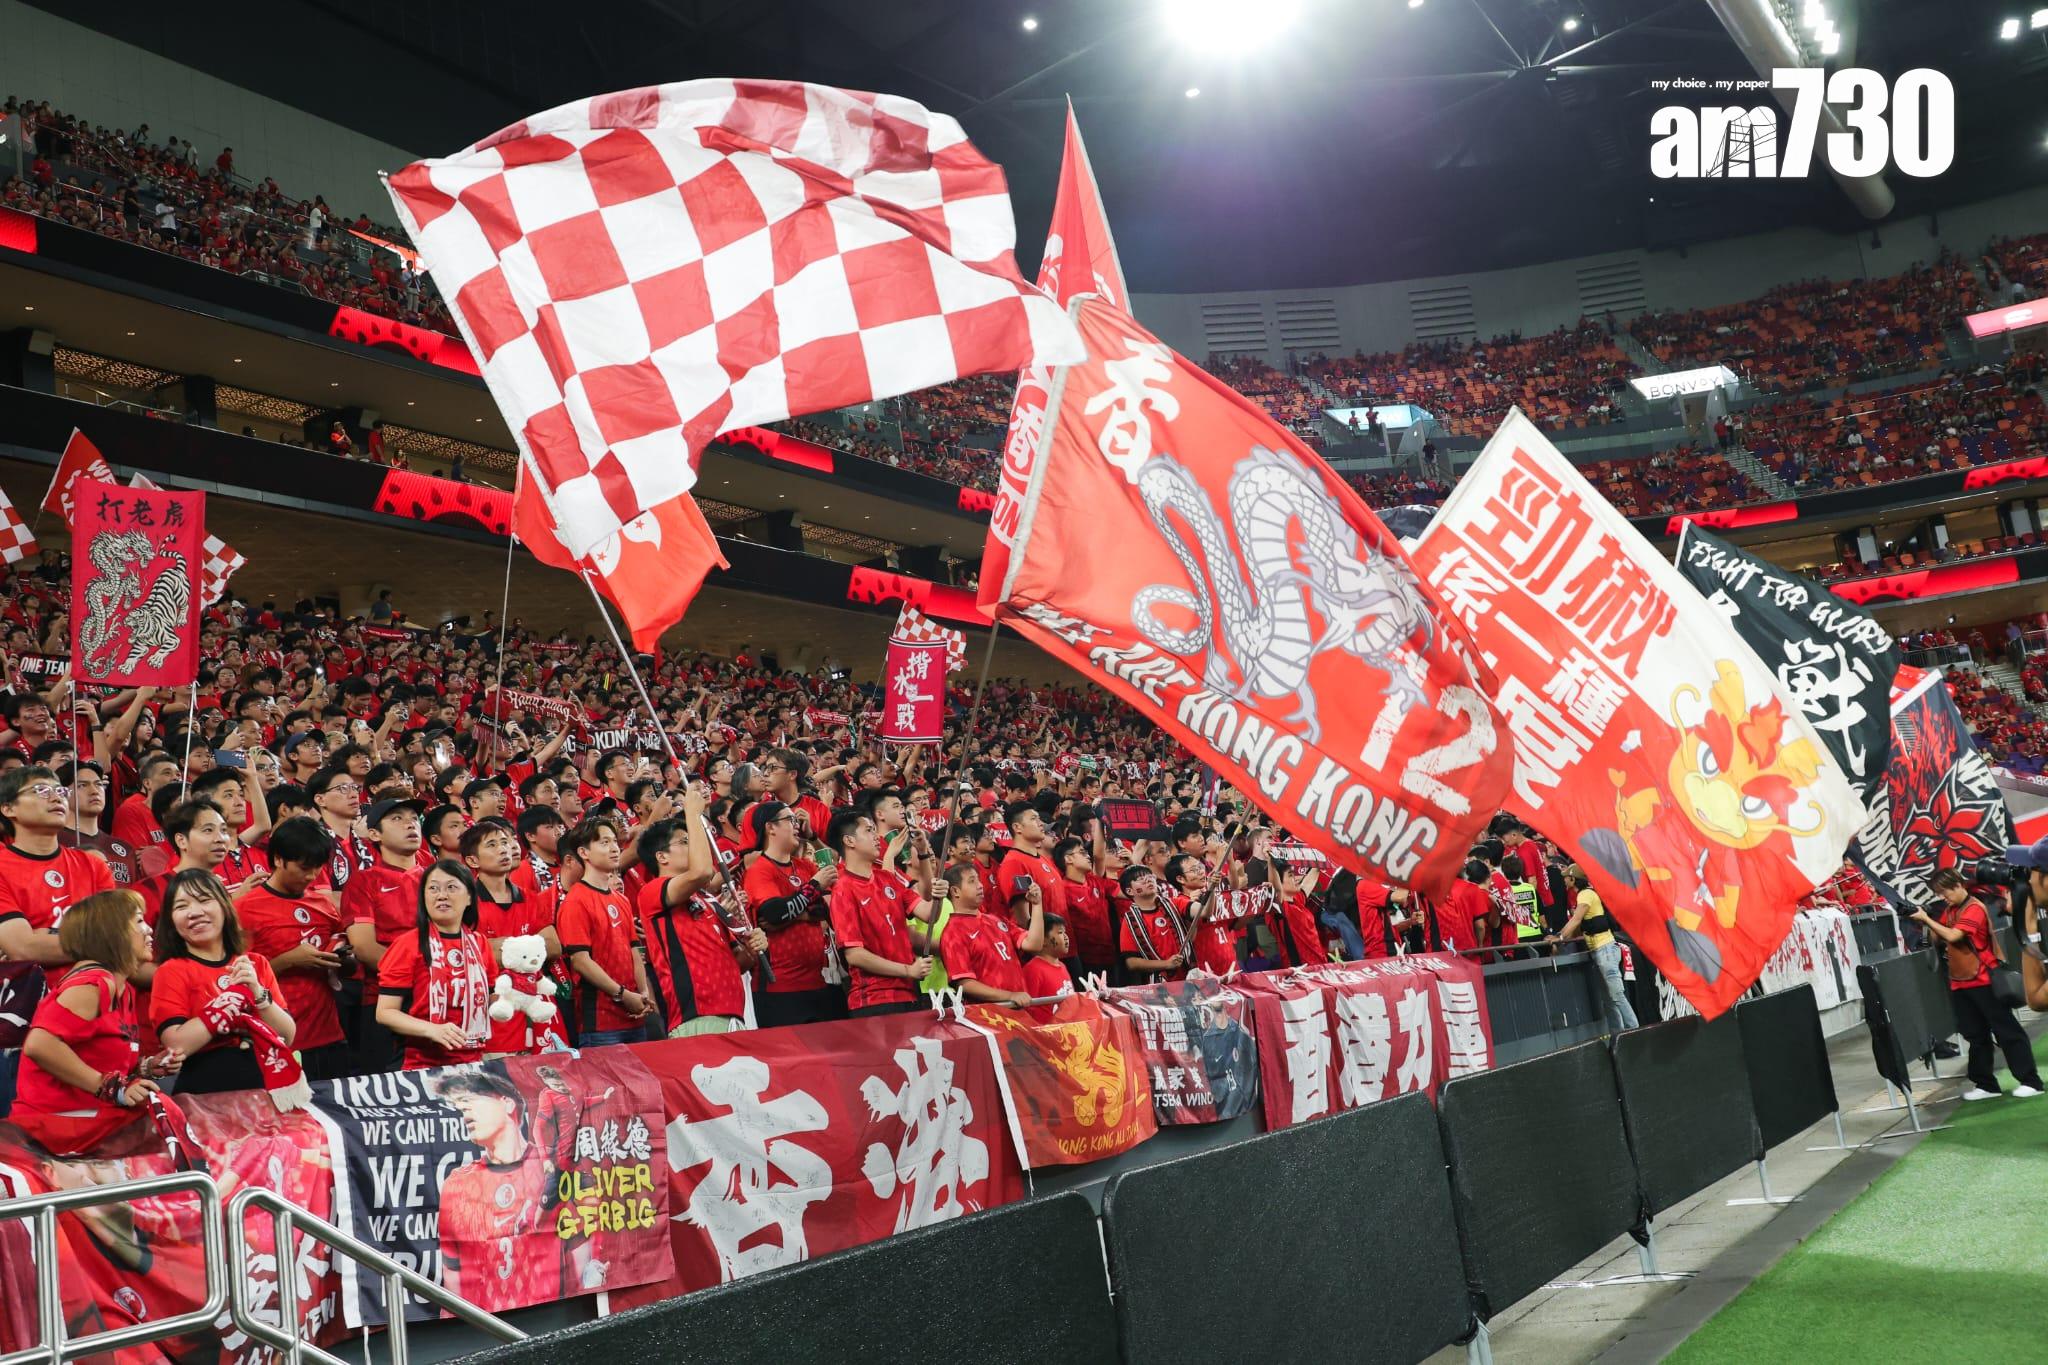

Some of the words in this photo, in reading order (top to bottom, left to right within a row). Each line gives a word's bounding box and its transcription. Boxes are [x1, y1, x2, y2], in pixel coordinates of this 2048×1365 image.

[96, 494, 187, 527] 打老虎
[1687, 540, 1764, 592] FIGHT
[20, 656, 43, 677] ONE
[45, 658, 71, 677] TEA
[594, 729, 630, 751] KON
[1089, 633, 1195, 708] ARE
[1176, 691, 1303, 804] HONG
[1296, 750, 1439, 882] KONG
[1957, 747, 1999, 799] WE
[361, 1121, 391, 1146] WE
[394, 1118, 436, 1145] CAN!
[1091, 1131, 1114, 1152] KONG
[368, 1153, 425, 1209] WE
[558, 1163, 654, 1202] OLIVER
[368, 1215, 399, 1242] WE
[557, 1198, 657, 1240] GERBIG
[499, 1236, 514, 1280] 3
